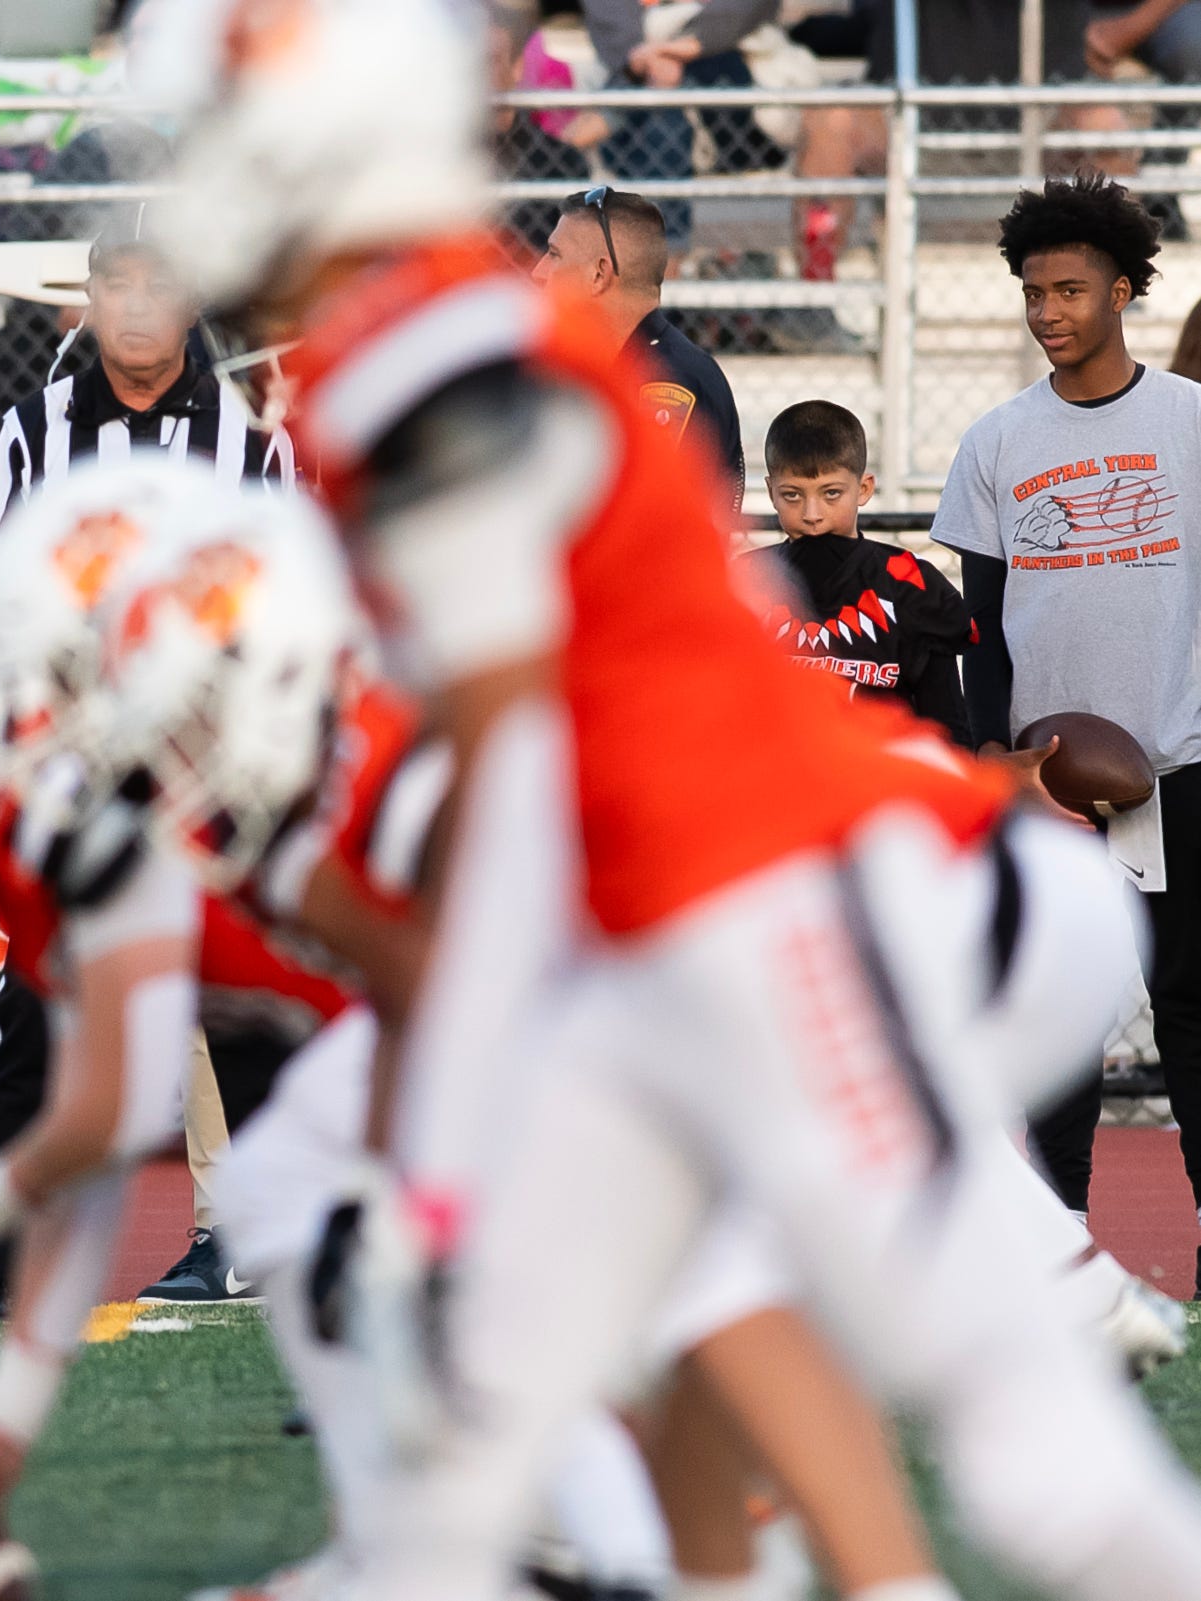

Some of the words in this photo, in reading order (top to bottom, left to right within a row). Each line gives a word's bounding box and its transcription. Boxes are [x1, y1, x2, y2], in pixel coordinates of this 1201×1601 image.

[1013, 458, 1100, 502] CENTRAL
[1104, 454, 1158, 473] YORK
[1011, 555, 1084, 570] PANTHERS
[1087, 551, 1104, 566] IN
[1107, 547, 1138, 563] THE
[1141, 537, 1181, 558] PARK
